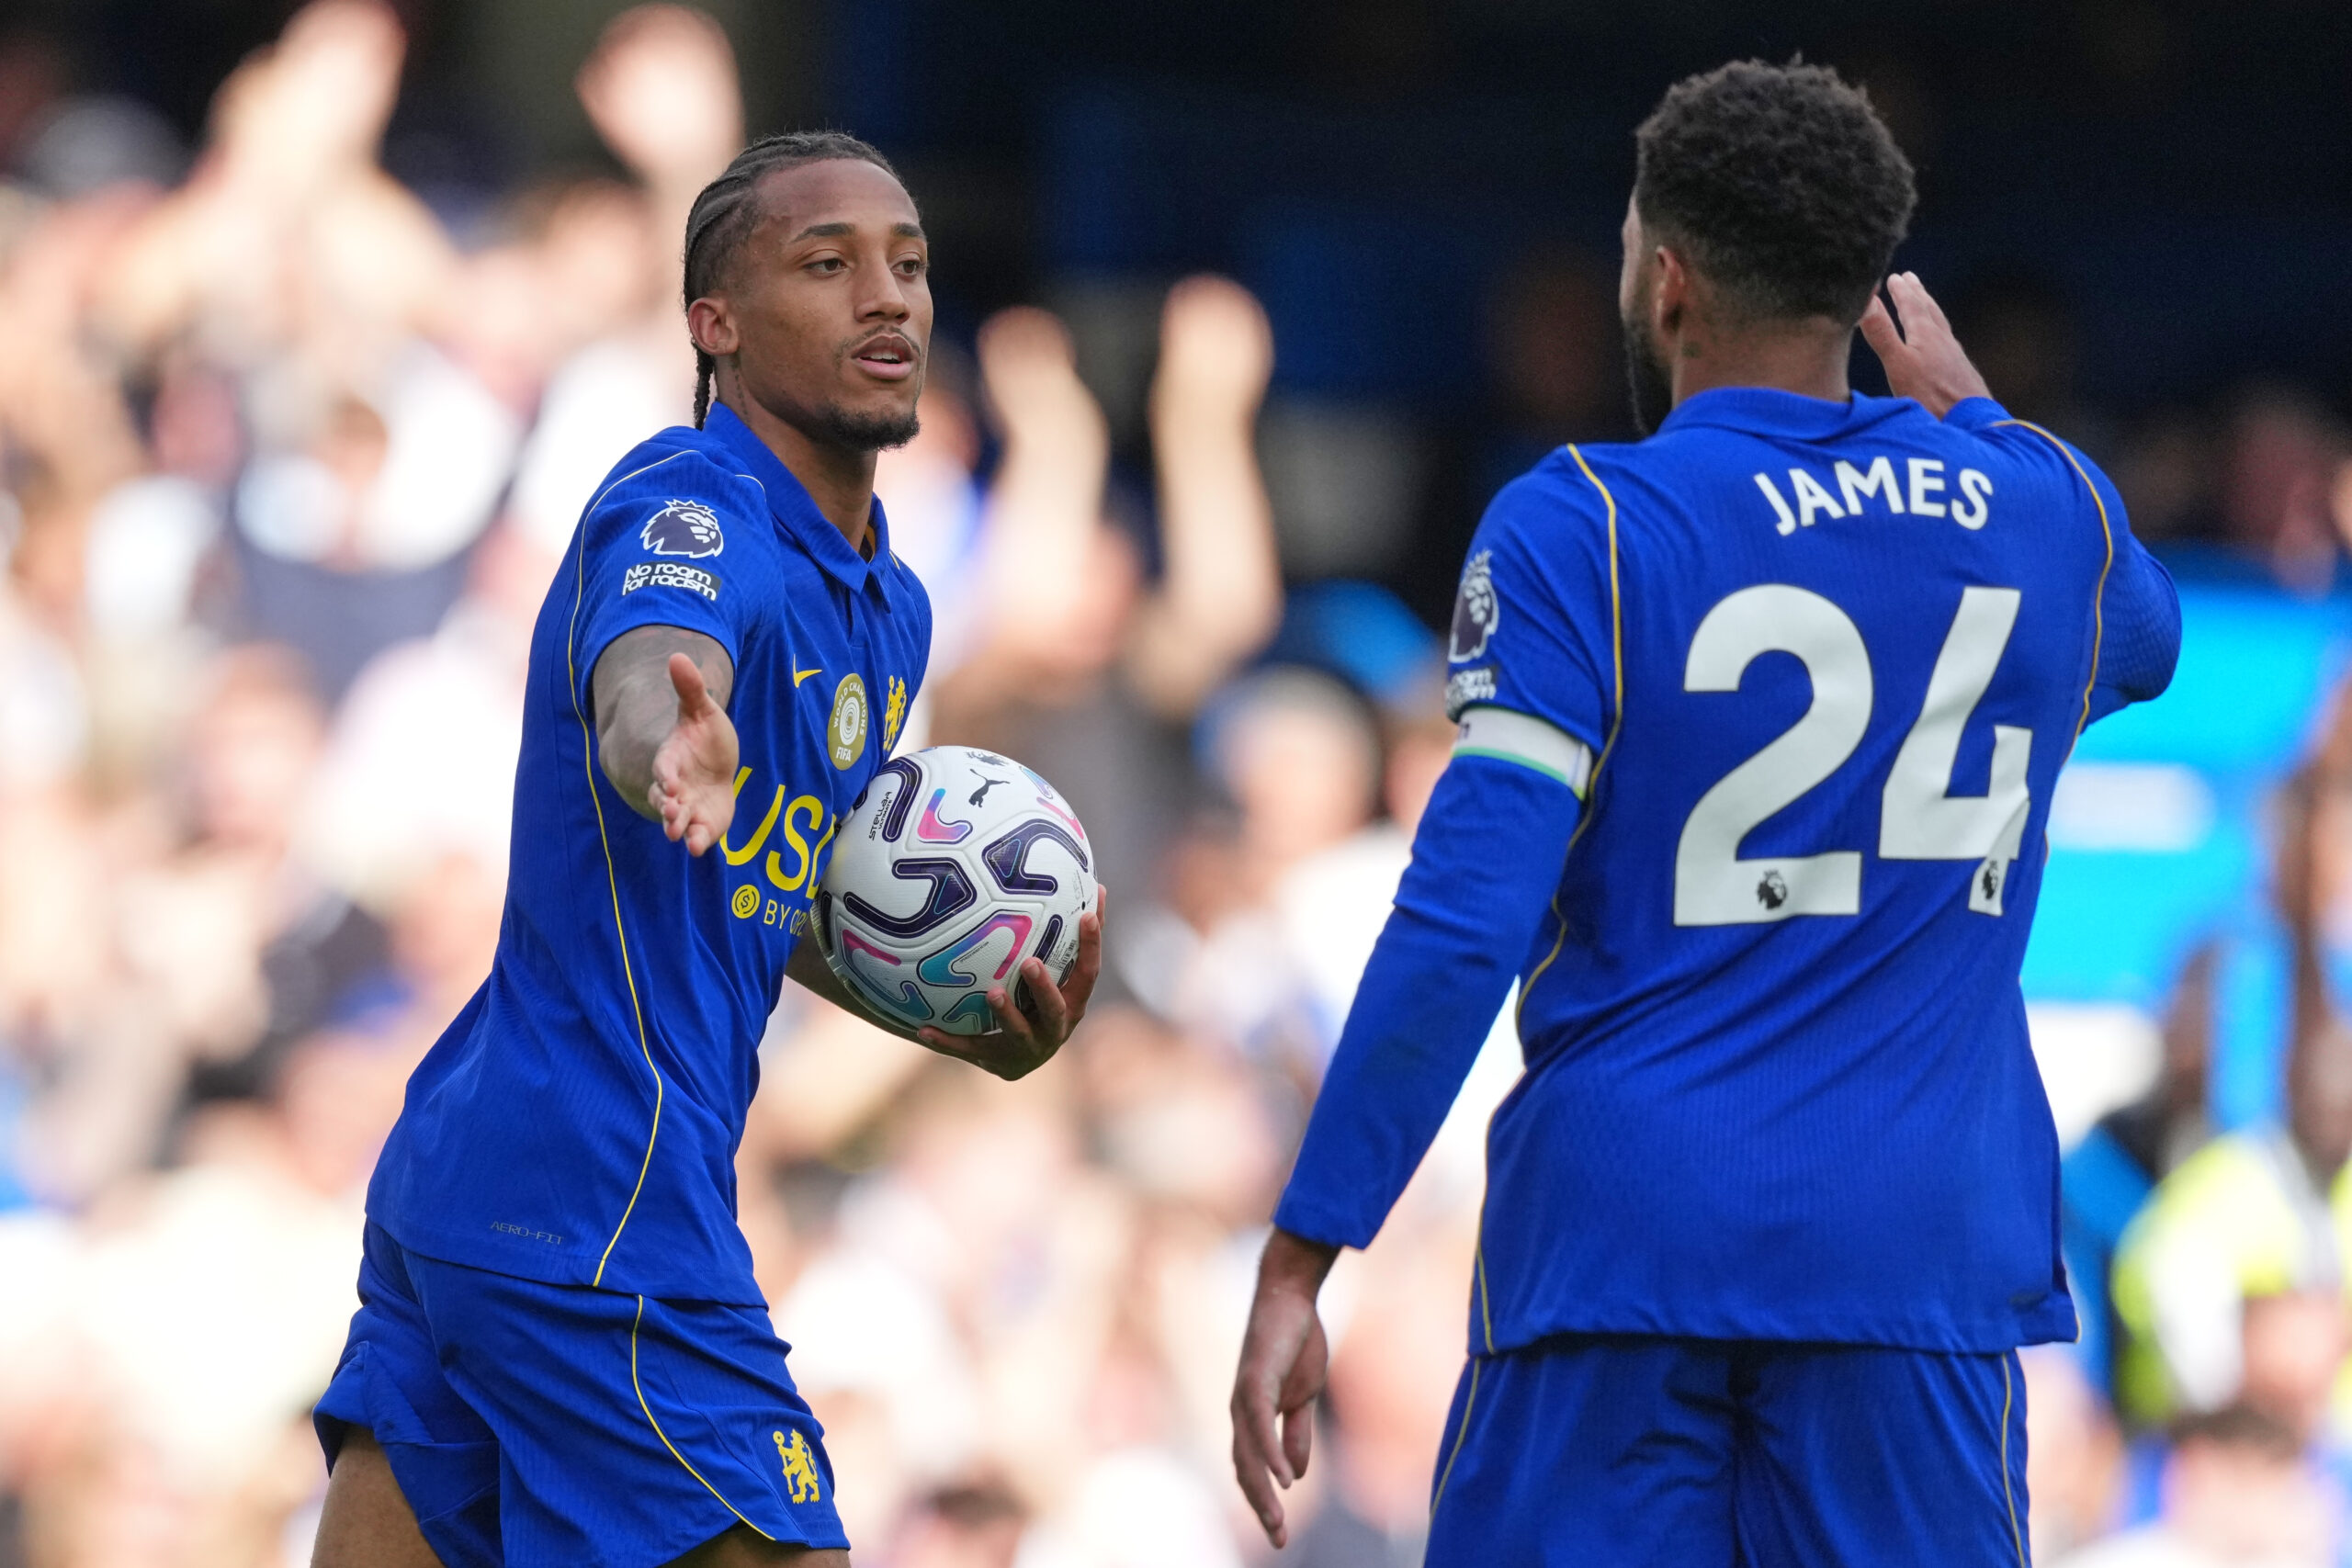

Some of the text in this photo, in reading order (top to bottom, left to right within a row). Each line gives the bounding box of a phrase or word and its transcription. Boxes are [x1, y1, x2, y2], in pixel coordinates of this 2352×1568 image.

[1754, 457, 1993, 536] JAMES
[622, 575, 717, 602] for racism
[625, 563, 712, 586] No room
[833, 682, 866, 736] WORLD CHAMPIONS
[836, 746, 853, 762] FIFA
[1673, 583, 2033, 926] 24
[878, 799, 892, 829] ULTIMATE
[763, 898, 791, 930] BY
[490, 1221, 563, 1246] AERO-FIT
